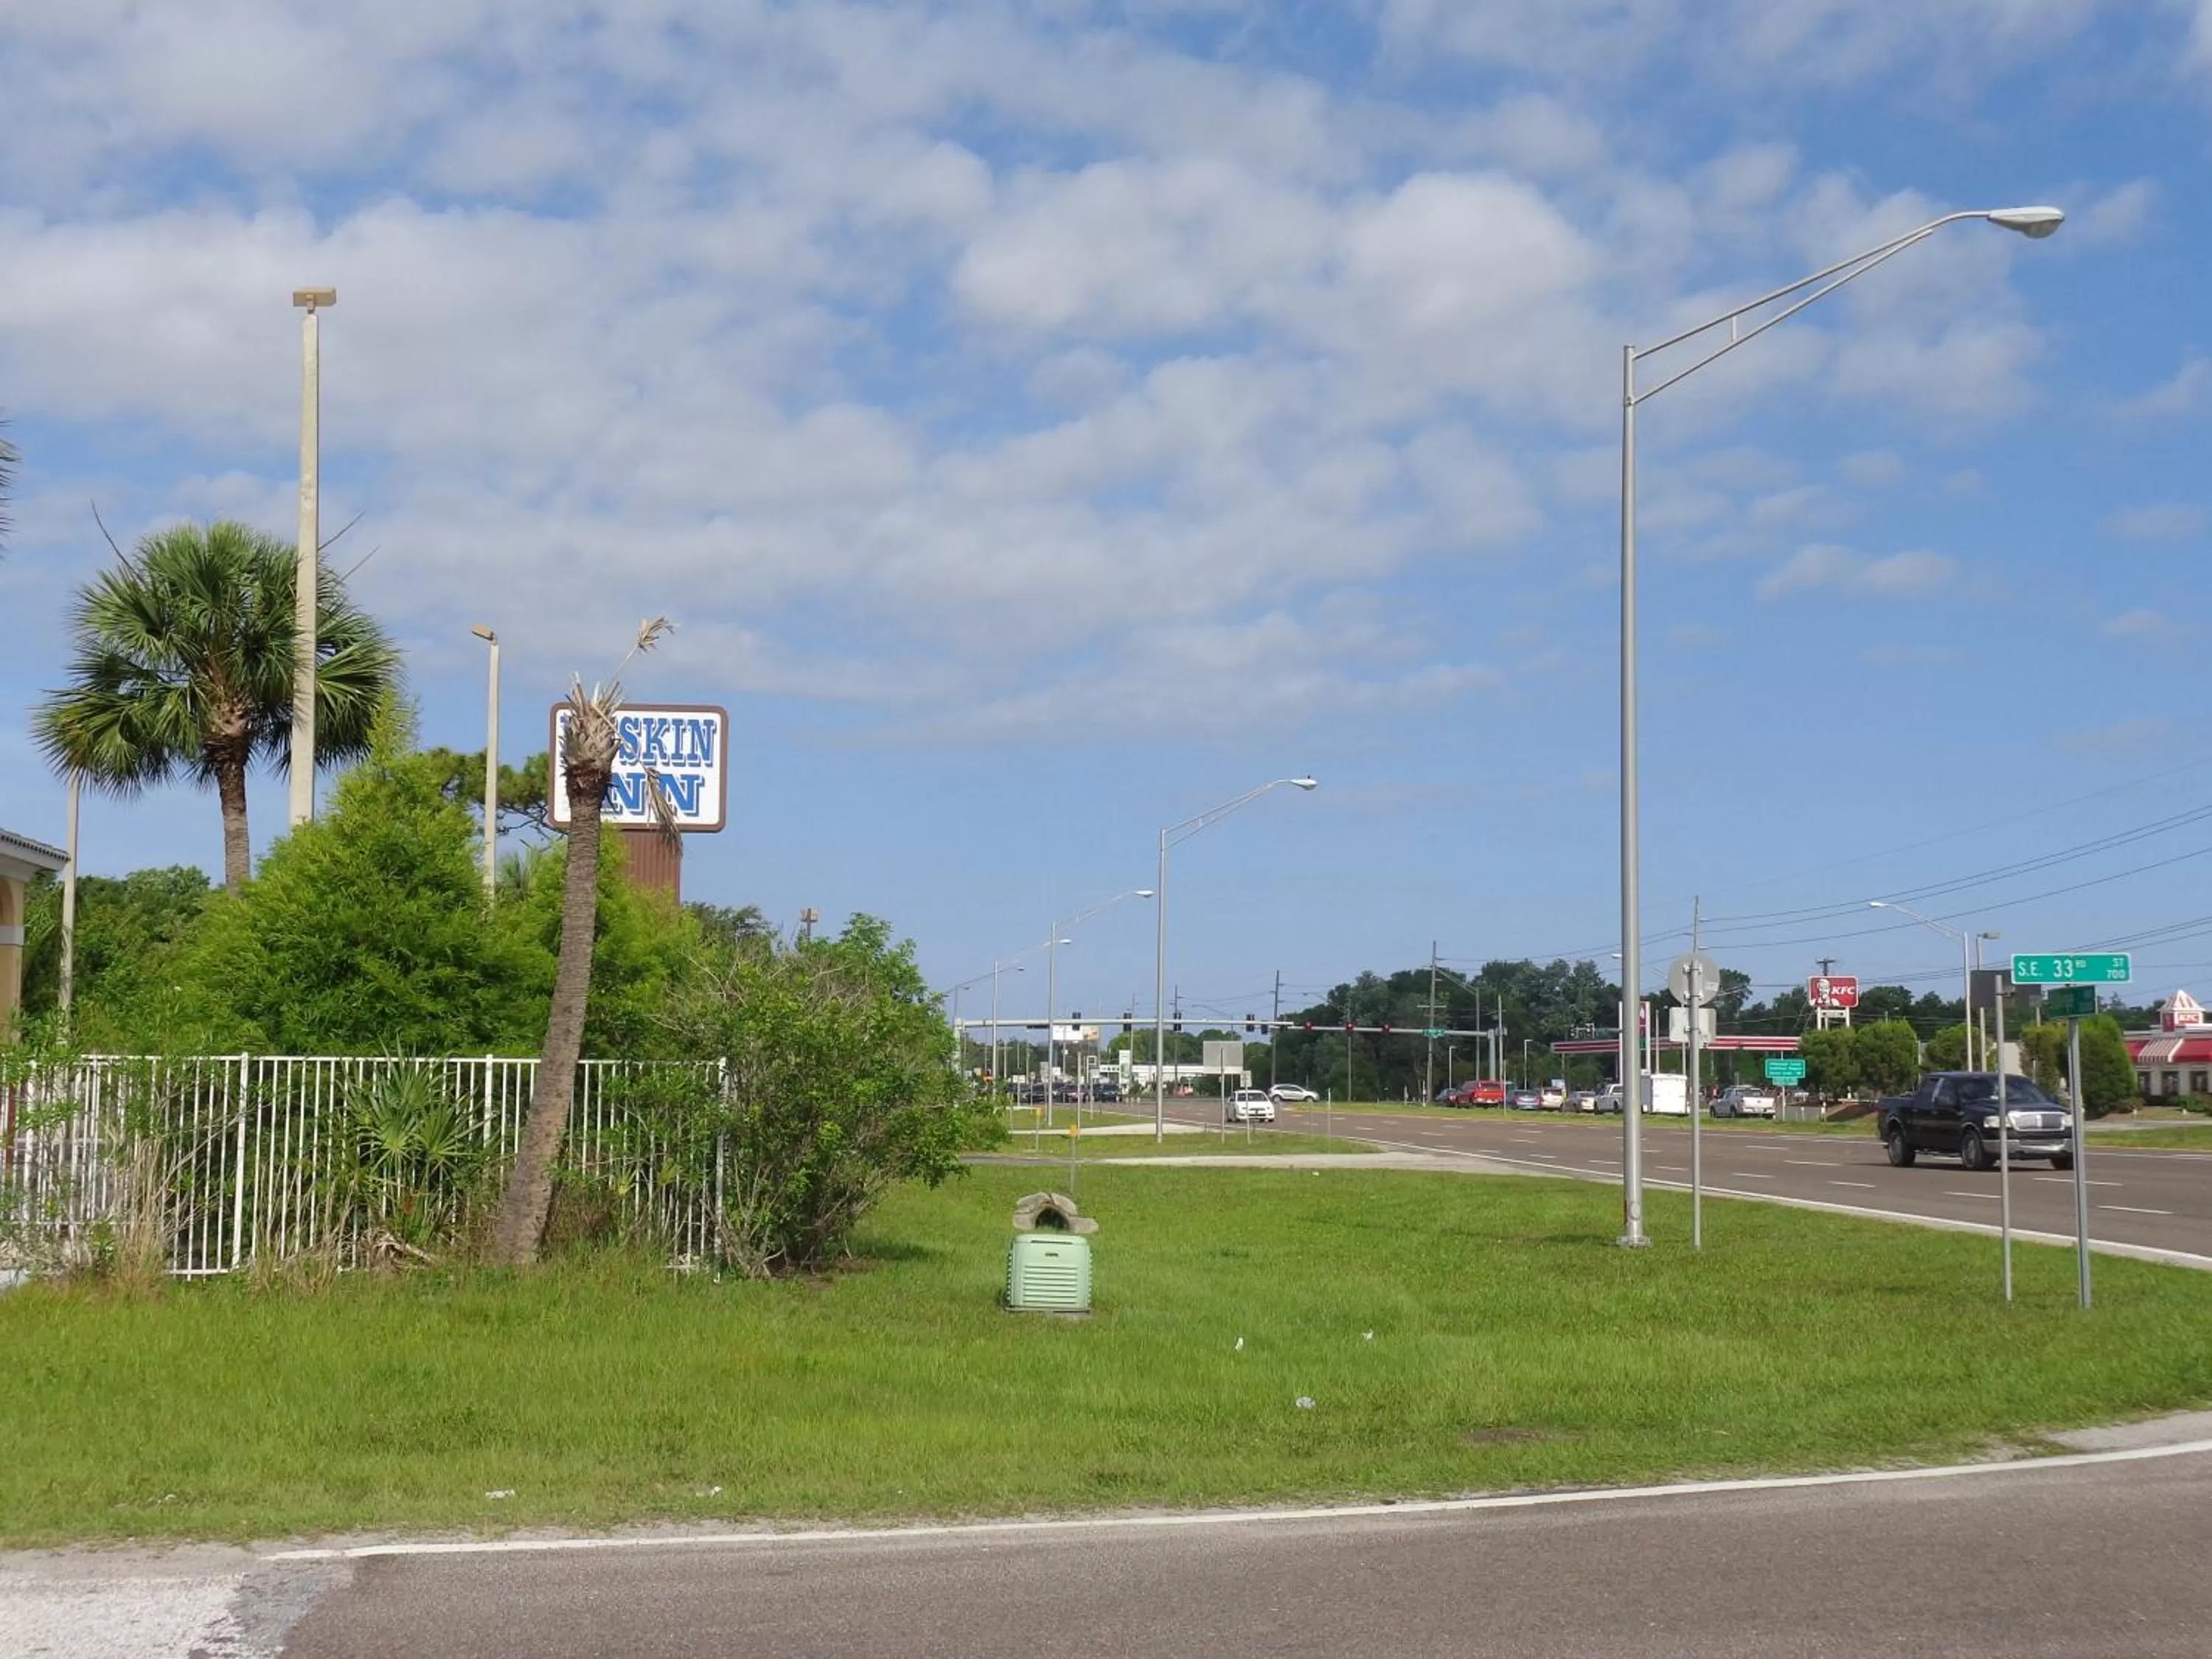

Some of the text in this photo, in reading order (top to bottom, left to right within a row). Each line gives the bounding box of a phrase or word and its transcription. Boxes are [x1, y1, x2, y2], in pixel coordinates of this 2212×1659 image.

[2017, 961, 2043, 977] S.E.
[2112, 958, 2124, 967] ST
[2106, 970, 2126, 979] 700
[1831, 986, 1855, 995] KFC
